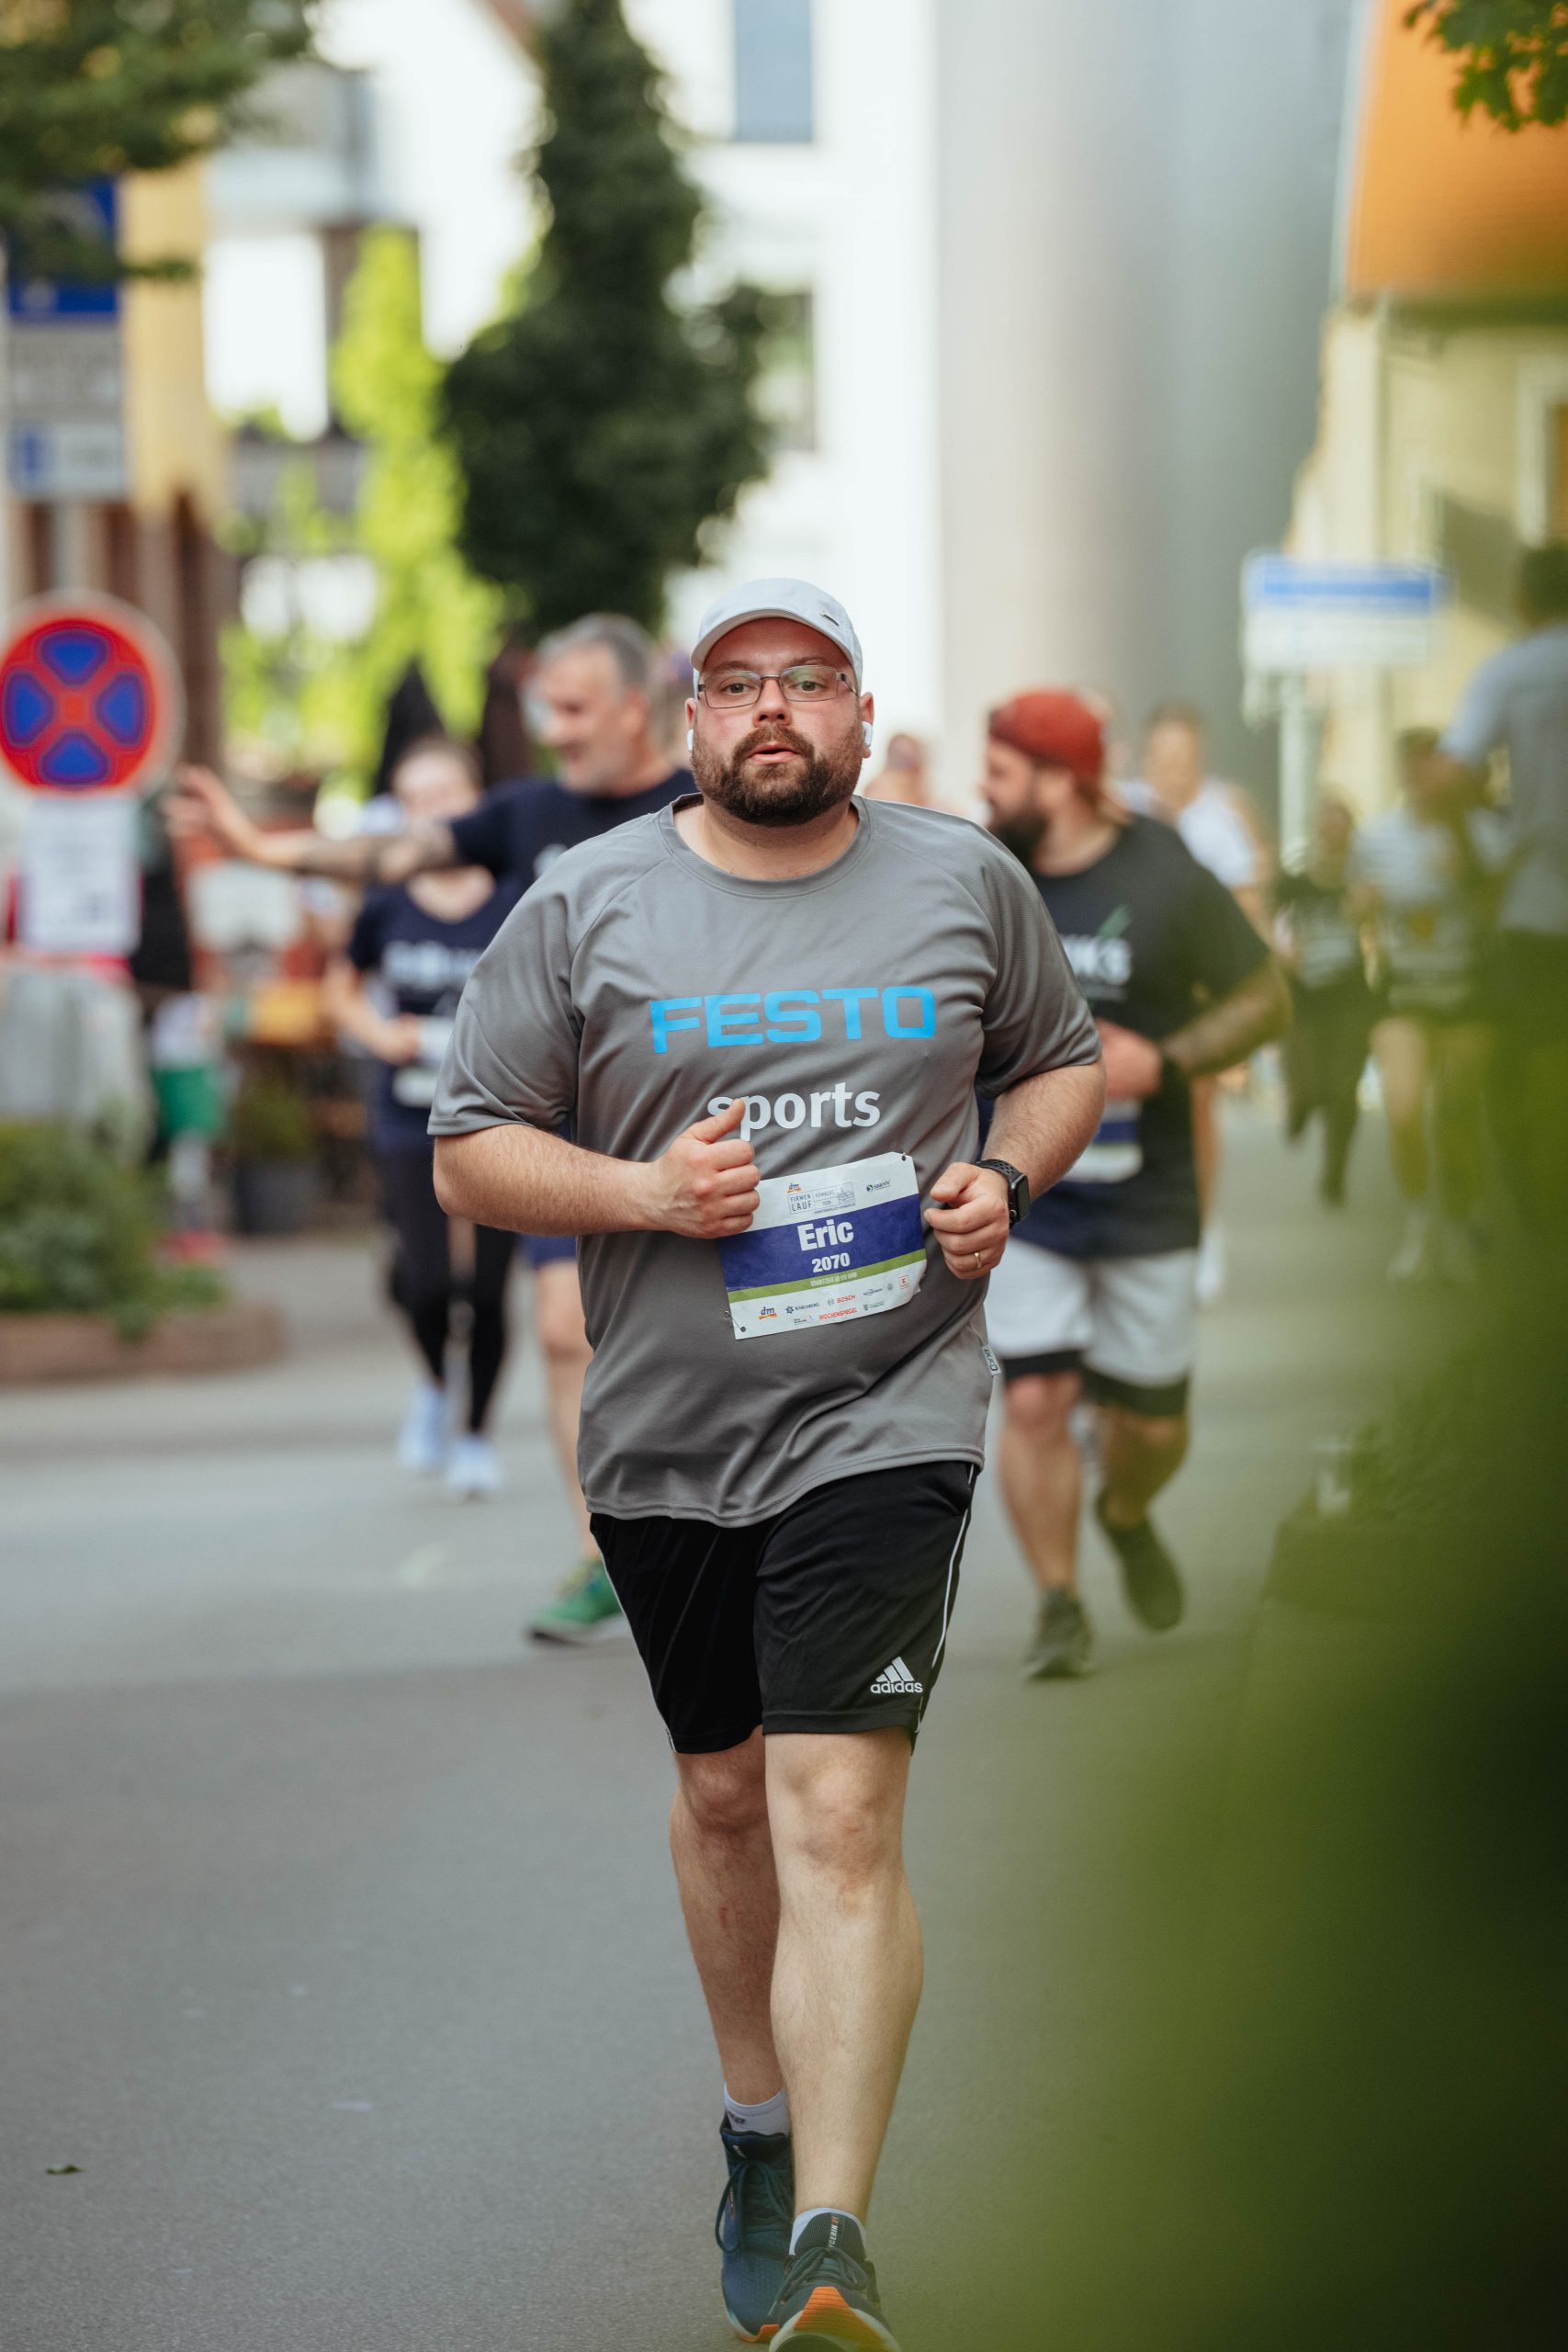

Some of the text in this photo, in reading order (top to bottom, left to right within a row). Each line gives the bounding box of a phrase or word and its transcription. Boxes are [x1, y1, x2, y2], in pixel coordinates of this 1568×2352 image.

[649, 986, 935, 1054] FESTO
[790, 1193, 811, 1203] FIRMEN
[791, 1200, 812, 1212] LAUF
[797, 1219, 854, 1250] Eric
[811, 1252, 851, 1273] 2070
[837, 1295, 856, 1304] BOSCH
[761, 1306, 775, 1316] dm
[870, 1680, 924, 1694] adidas
[828, 2224, 838, 2248] YCERIN
